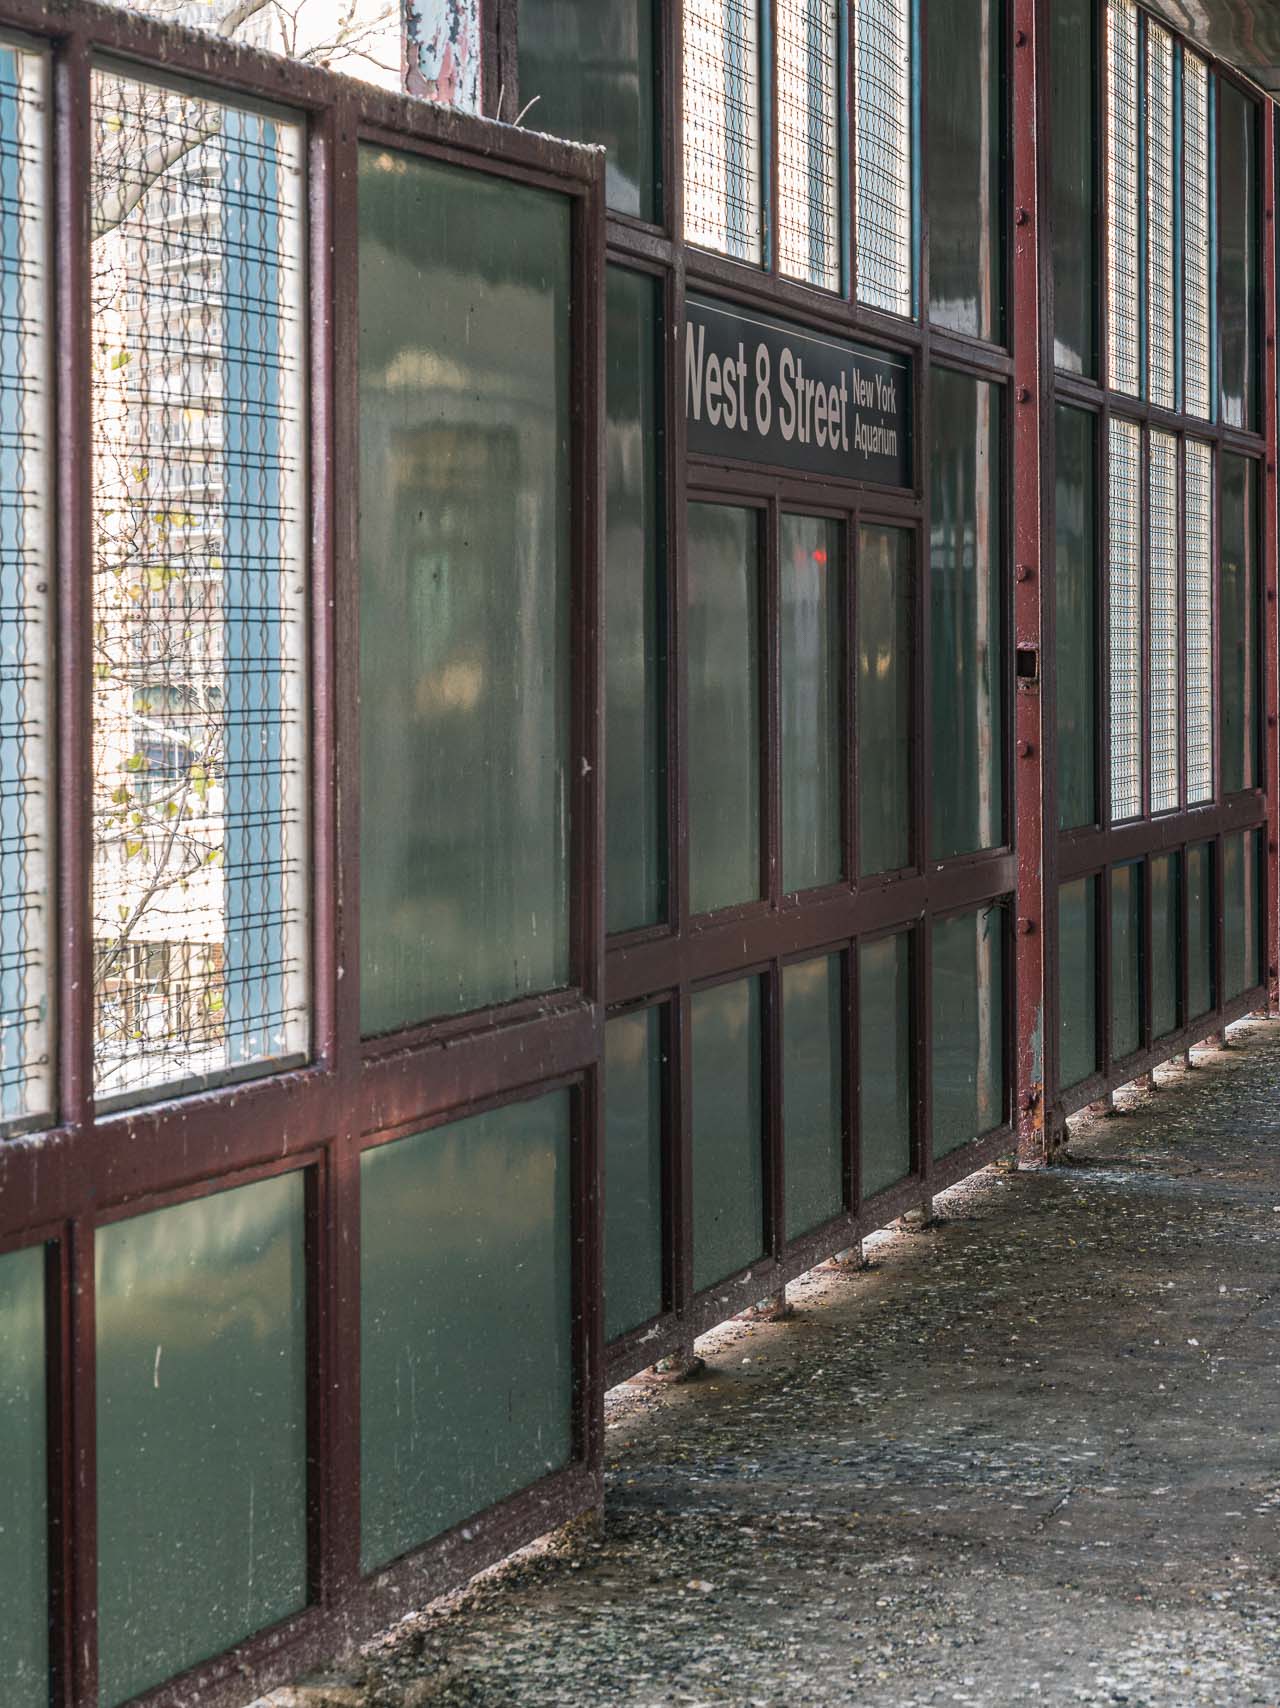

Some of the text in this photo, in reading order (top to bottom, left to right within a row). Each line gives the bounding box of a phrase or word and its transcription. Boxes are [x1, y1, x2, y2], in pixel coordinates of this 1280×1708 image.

[755, 343, 772, 436] 8
[779, 347, 849, 452] Street
[853, 368, 896, 414] New York
[854, 413, 897, 459] Aquarium
